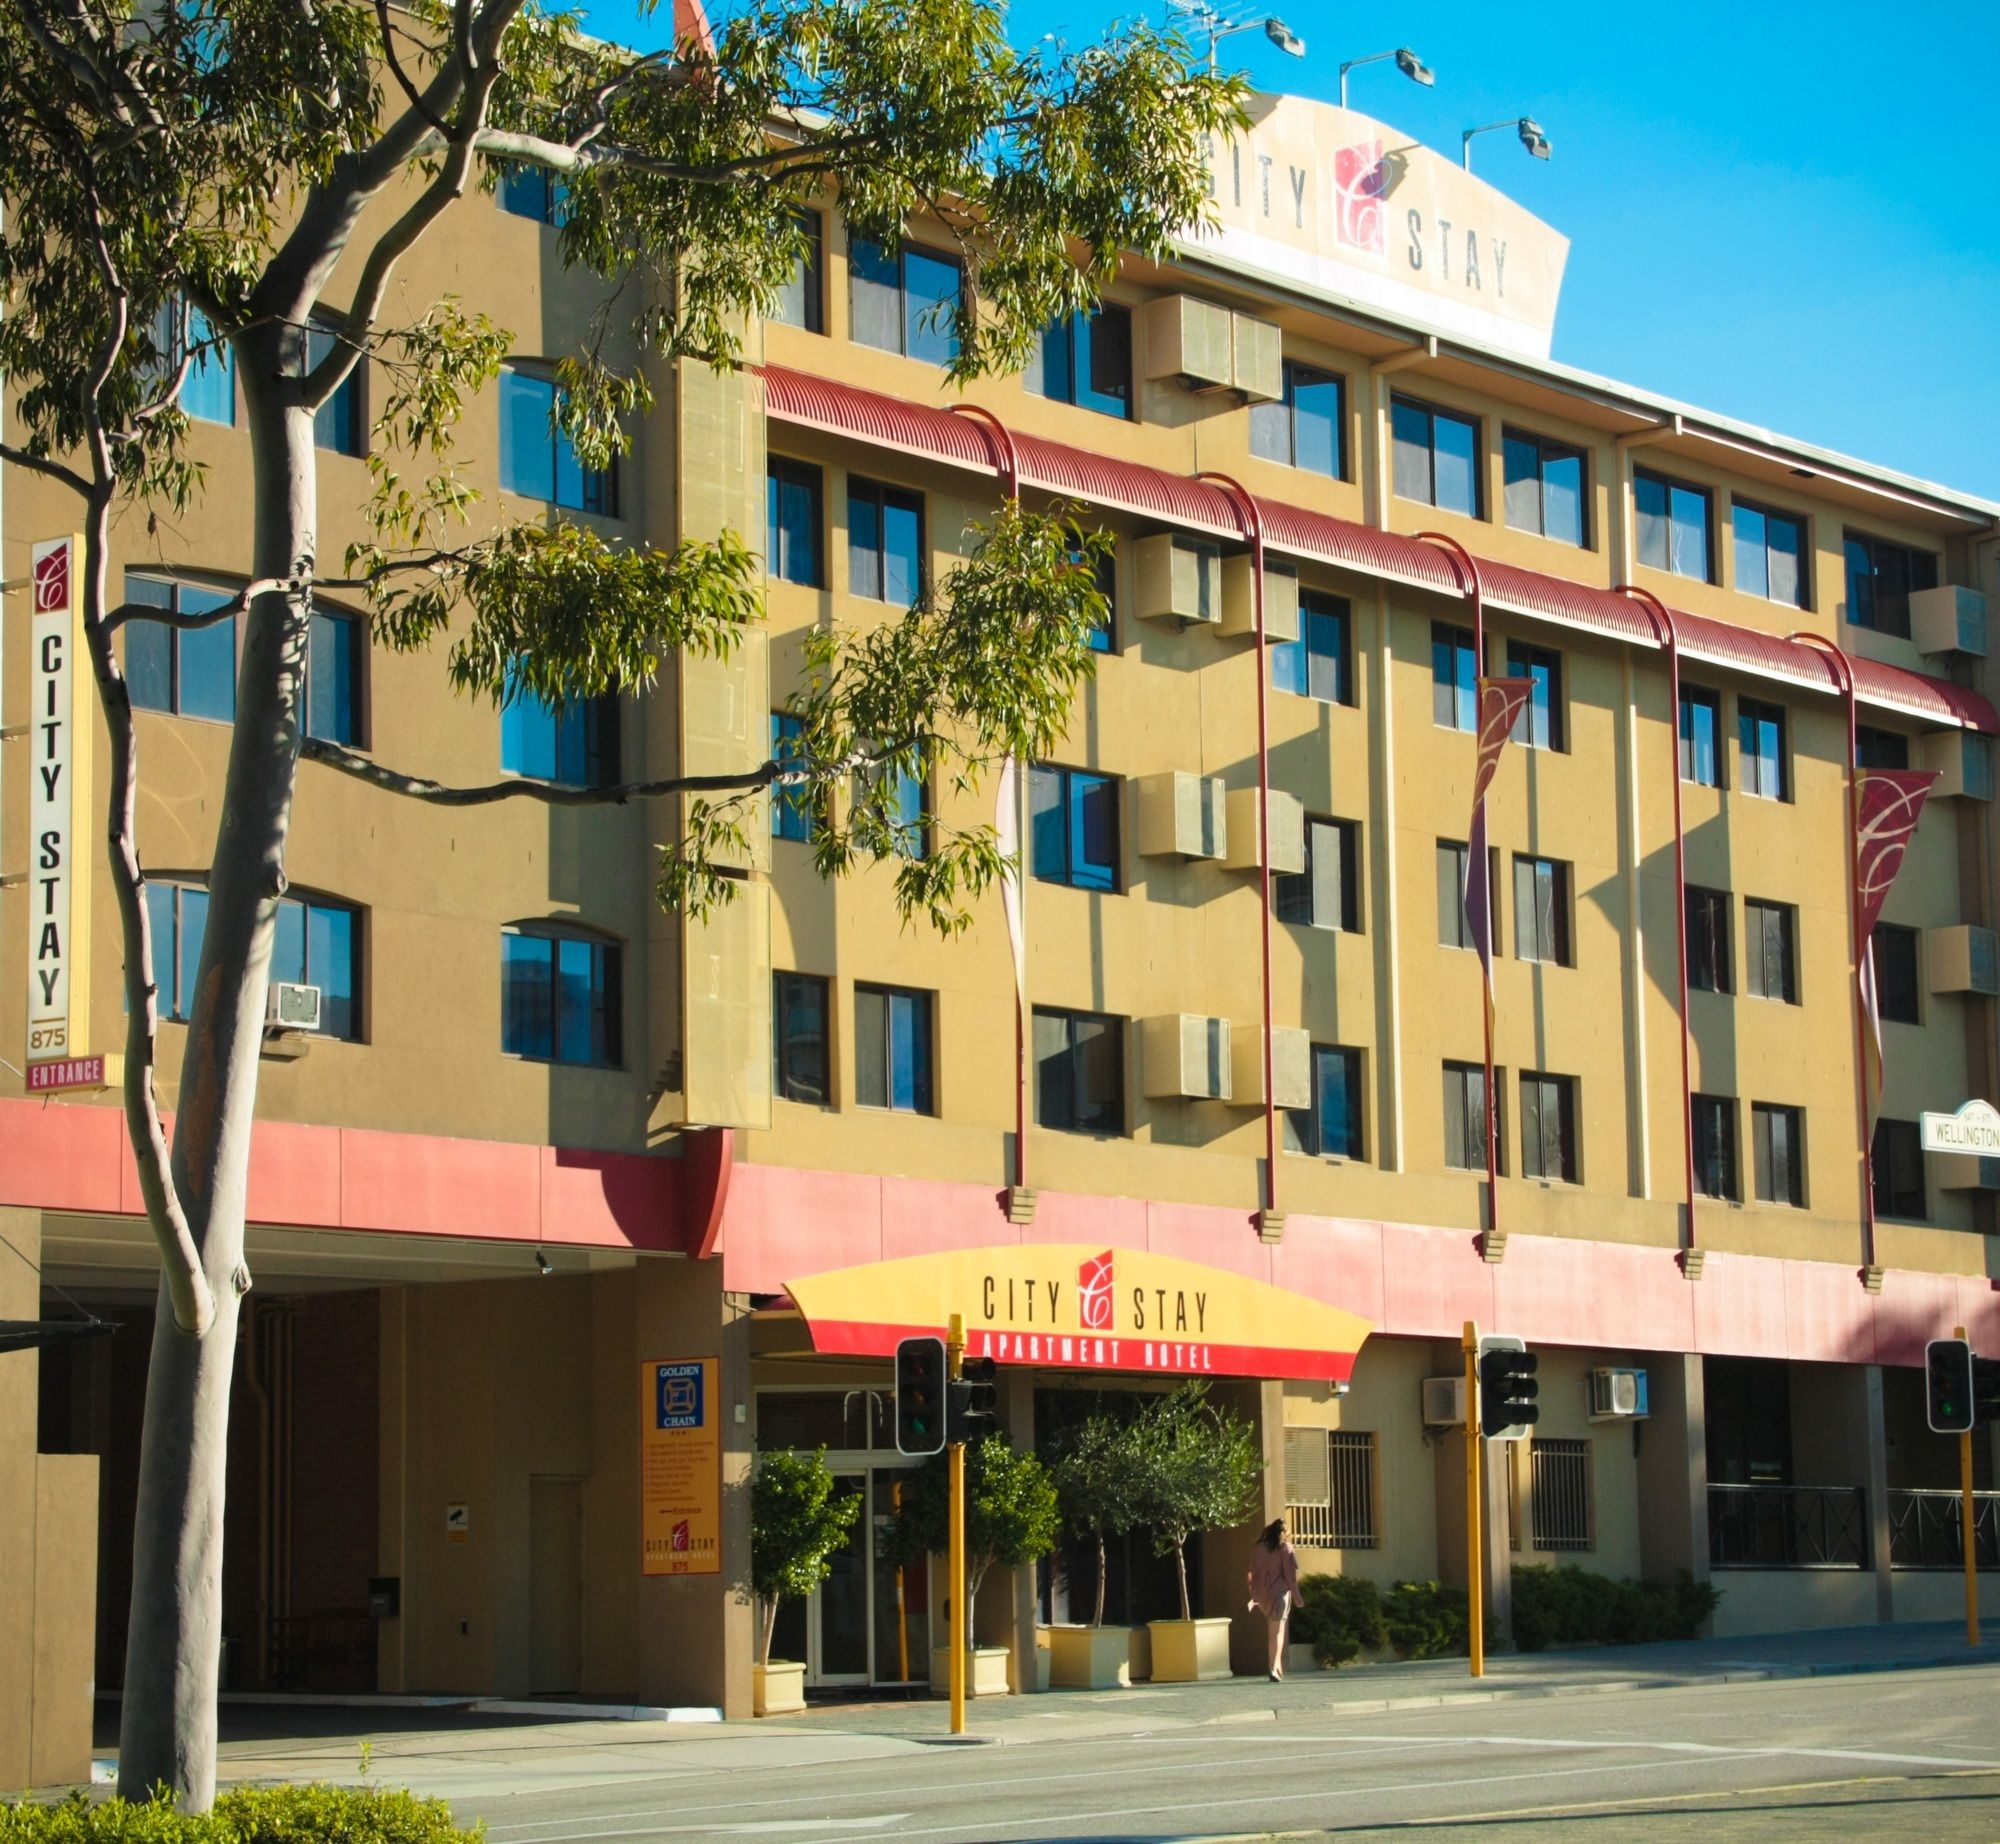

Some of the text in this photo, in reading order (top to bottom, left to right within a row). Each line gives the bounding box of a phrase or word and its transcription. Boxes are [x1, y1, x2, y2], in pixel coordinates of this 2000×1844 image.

[1200, 132, 1305, 229] CITY
[1408, 208, 1507, 298] STAY
[38, 634, 63, 1007] CITY STAY
[31, 1027, 65, 1049] 875
[32, 1060, 100, 1087] ENTRANCE
[1936, 1122, 2000, 1147] WELLINGTON
[983, 1275, 1060, 1324] CITY
[1133, 1287, 1207, 1333] STAY
[982, 1333, 1211, 1370] APARTMENT HOTEL
[660, 1365, 700, 1377] GOLDEN
[664, 1416, 696, 1427] CHAIN
